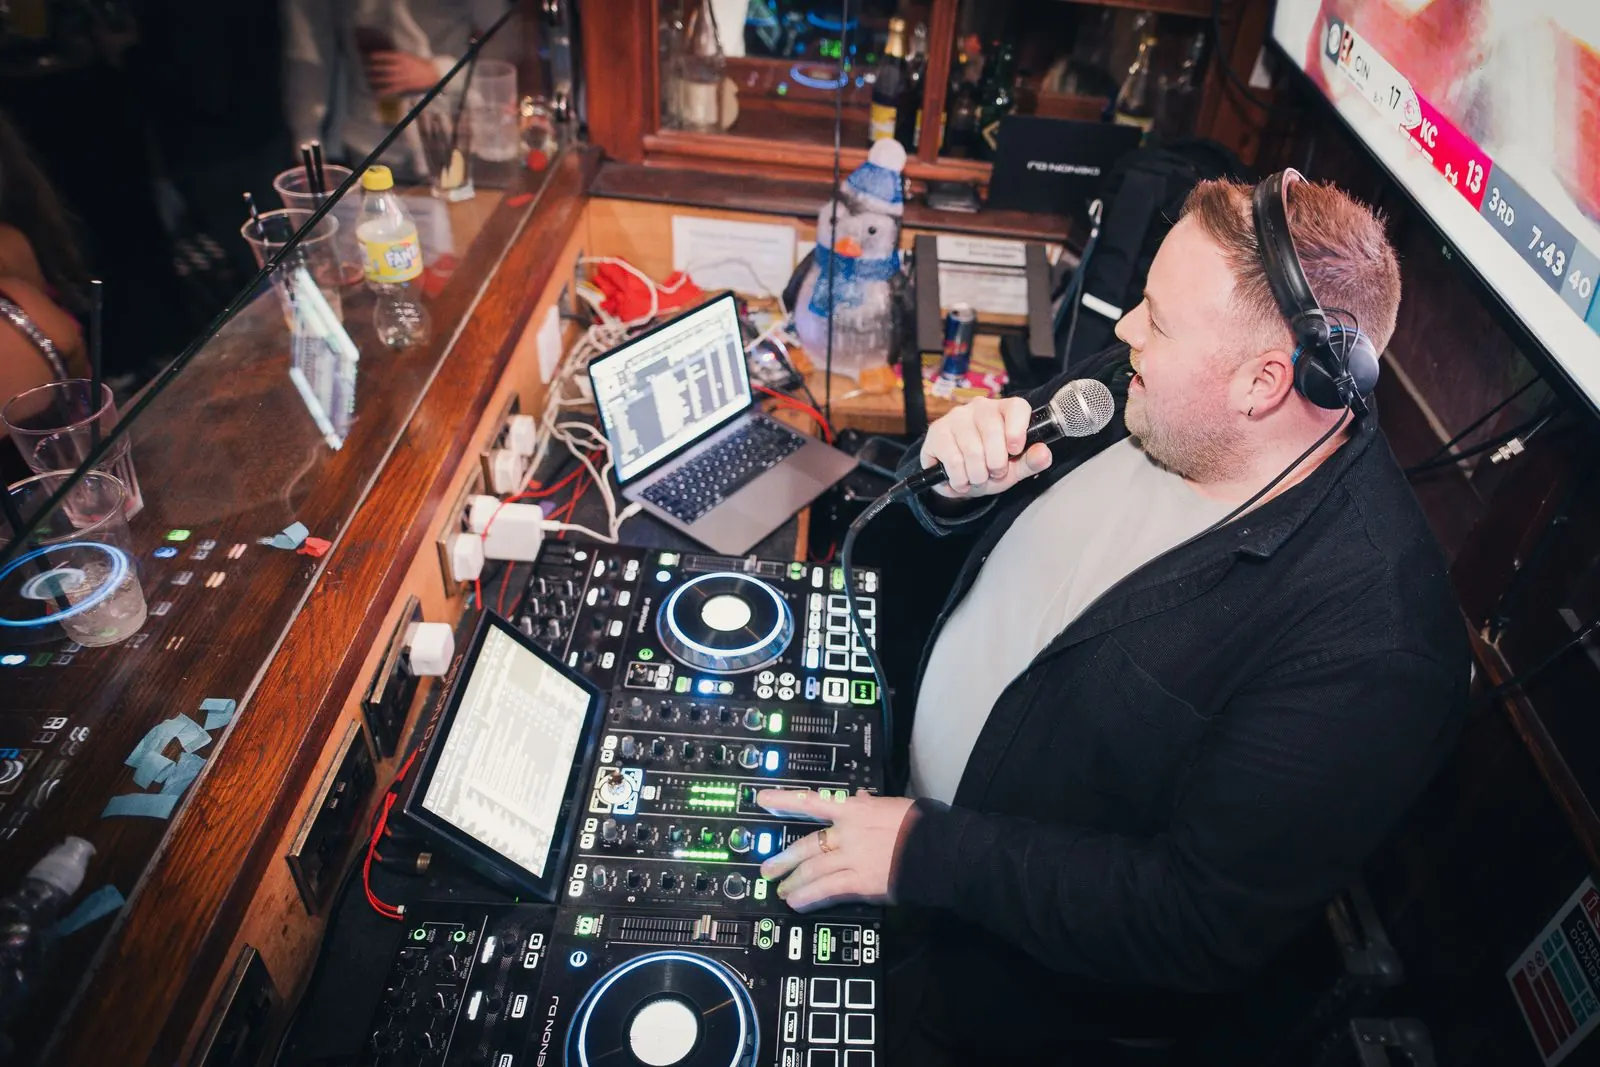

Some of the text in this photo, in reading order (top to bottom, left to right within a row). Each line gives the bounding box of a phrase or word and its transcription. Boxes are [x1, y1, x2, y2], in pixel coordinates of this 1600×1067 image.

[1354, 55, 1370, 81] CIN
[1388, 85, 1401, 110] 17
[1420, 117, 1438, 149] KC
[1465, 159, 1484, 194] 13
[1488, 187, 1566, 277] 3RD 7:43
[1568, 268, 1592, 299] 40
[627, 895, 636, 903] 3
[1569, 928, 1600, 989] DIOXIDE
[548, 996, 559, 1017] DJ
